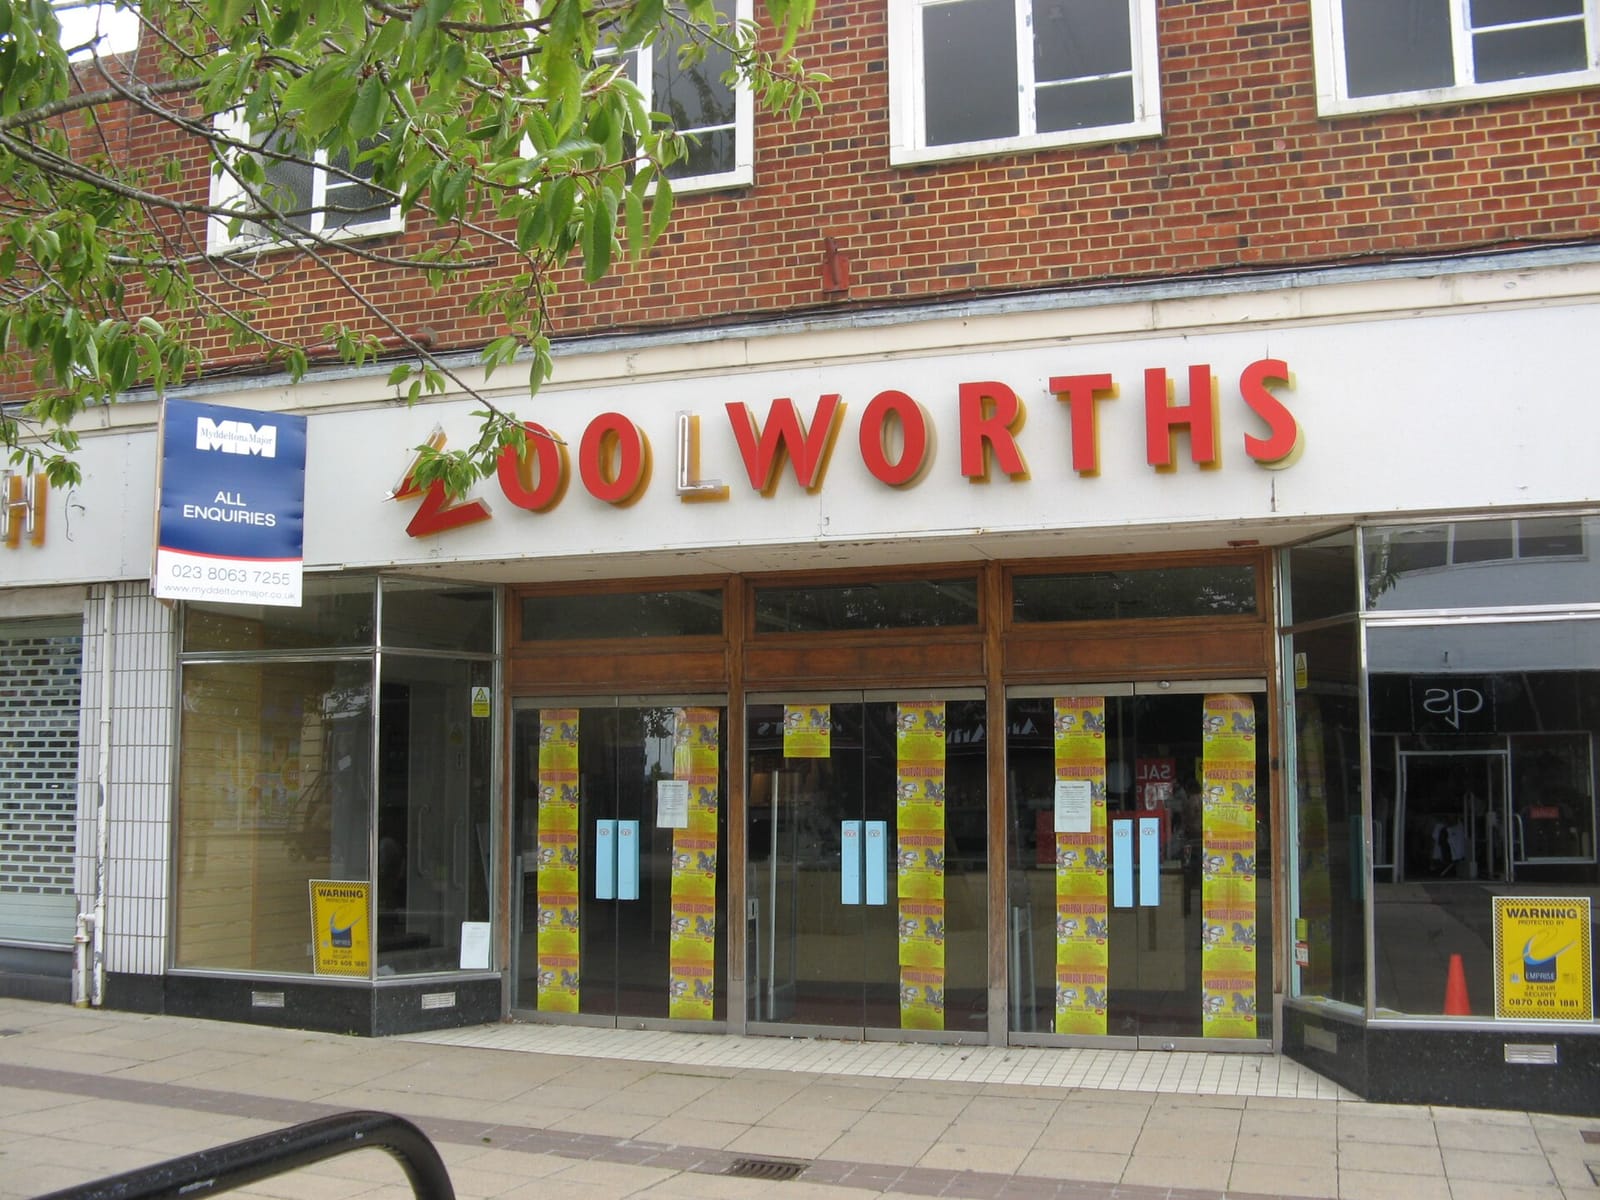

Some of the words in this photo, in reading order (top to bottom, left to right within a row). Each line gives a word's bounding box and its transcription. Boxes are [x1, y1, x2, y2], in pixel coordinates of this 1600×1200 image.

[214, 490, 247, 507] ALL
[183, 504, 276, 527] ENQUIRIES
[171, 564, 202, 579] 023
[207, 567, 247, 583] 8063
[253, 570, 291, 586] 7255
[318, 888, 363, 898] WARNING
[1506, 907, 1578, 919] WARNING
[1536, 999, 1555, 1007] 608
